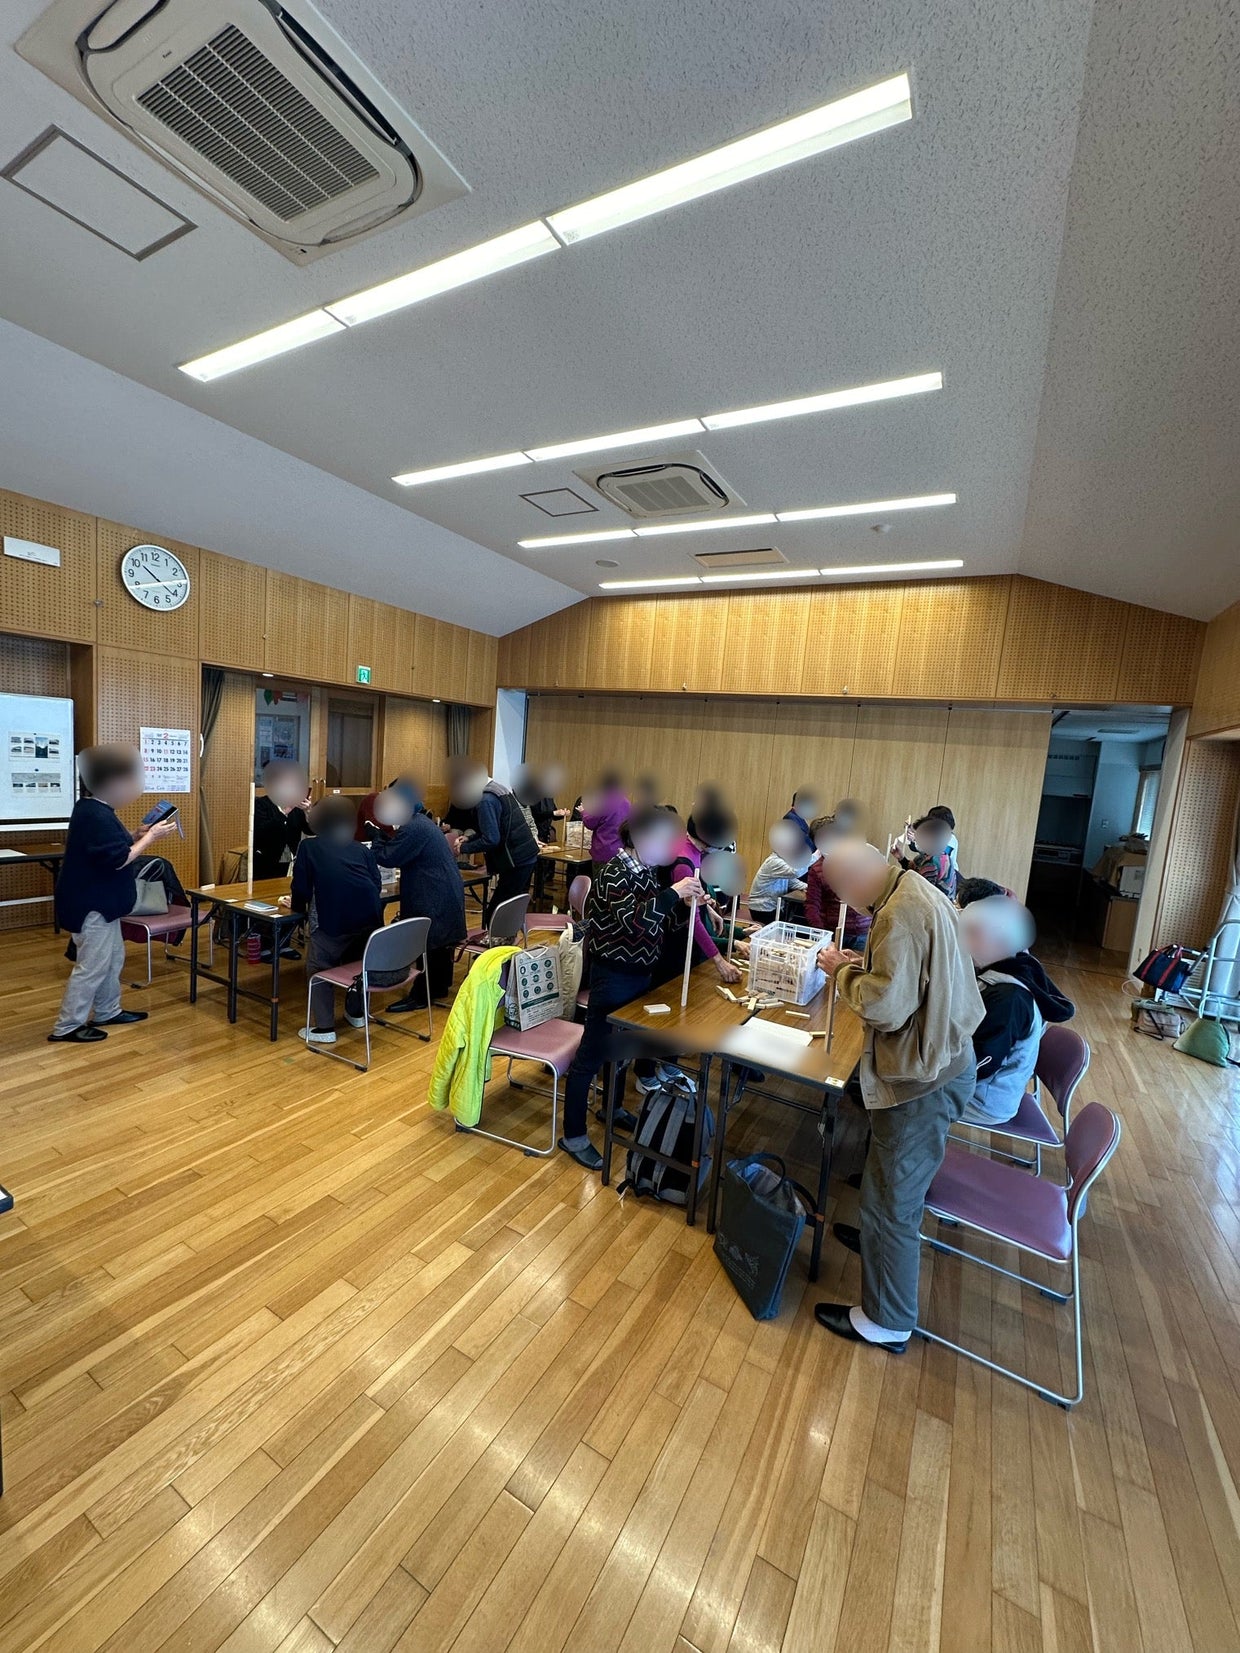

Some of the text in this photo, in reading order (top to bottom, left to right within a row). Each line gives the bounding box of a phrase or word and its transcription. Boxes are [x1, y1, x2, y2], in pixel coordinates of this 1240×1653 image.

[141, 553, 147, 562] 11
[151, 552, 160, 562] 12
[131, 558, 140, 567] 10
[128, 569, 134, 577] 9
[172, 568, 178, 576] 2
[144, 590, 149, 598] 7
[166, 595, 171, 603] 5
